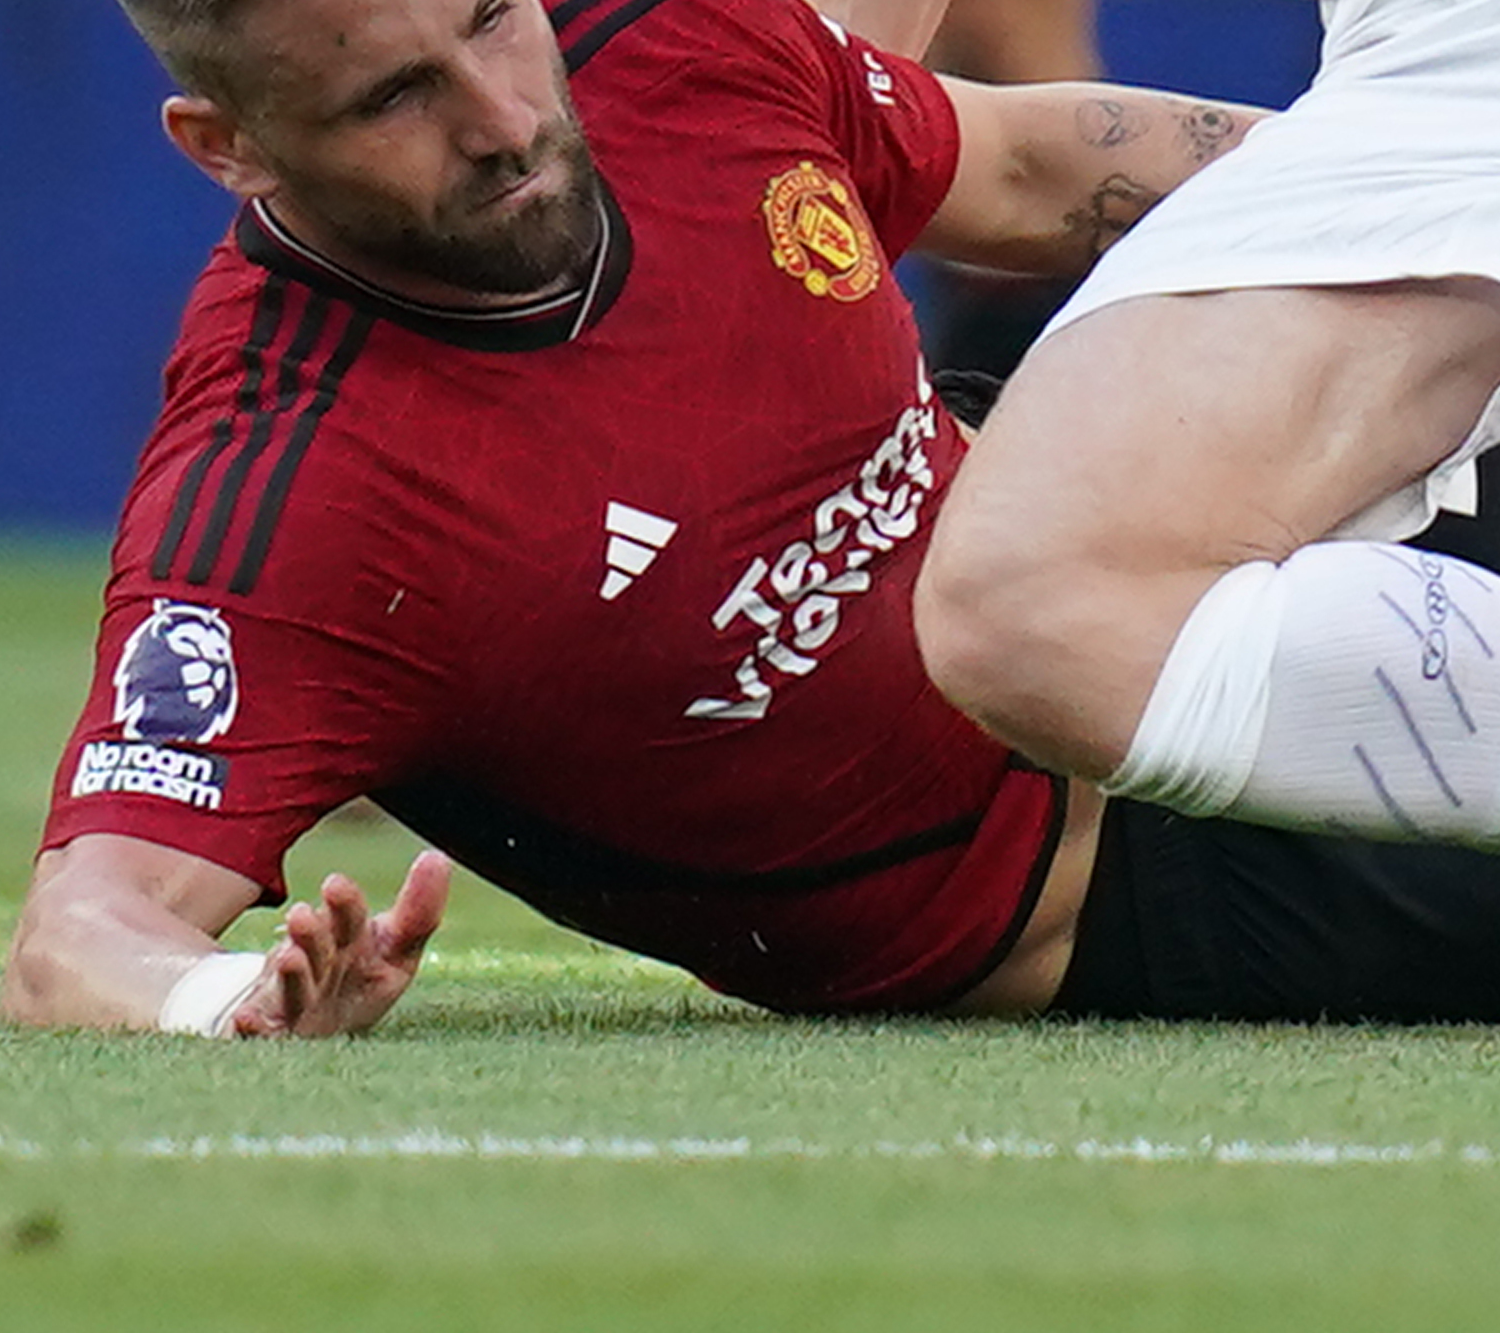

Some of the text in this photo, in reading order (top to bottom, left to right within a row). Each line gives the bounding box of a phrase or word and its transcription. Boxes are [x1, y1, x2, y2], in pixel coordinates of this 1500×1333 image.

[712, 406, 935, 632] Team
[80, 741, 213, 783] No room
[71, 767, 222, 811] for racism
